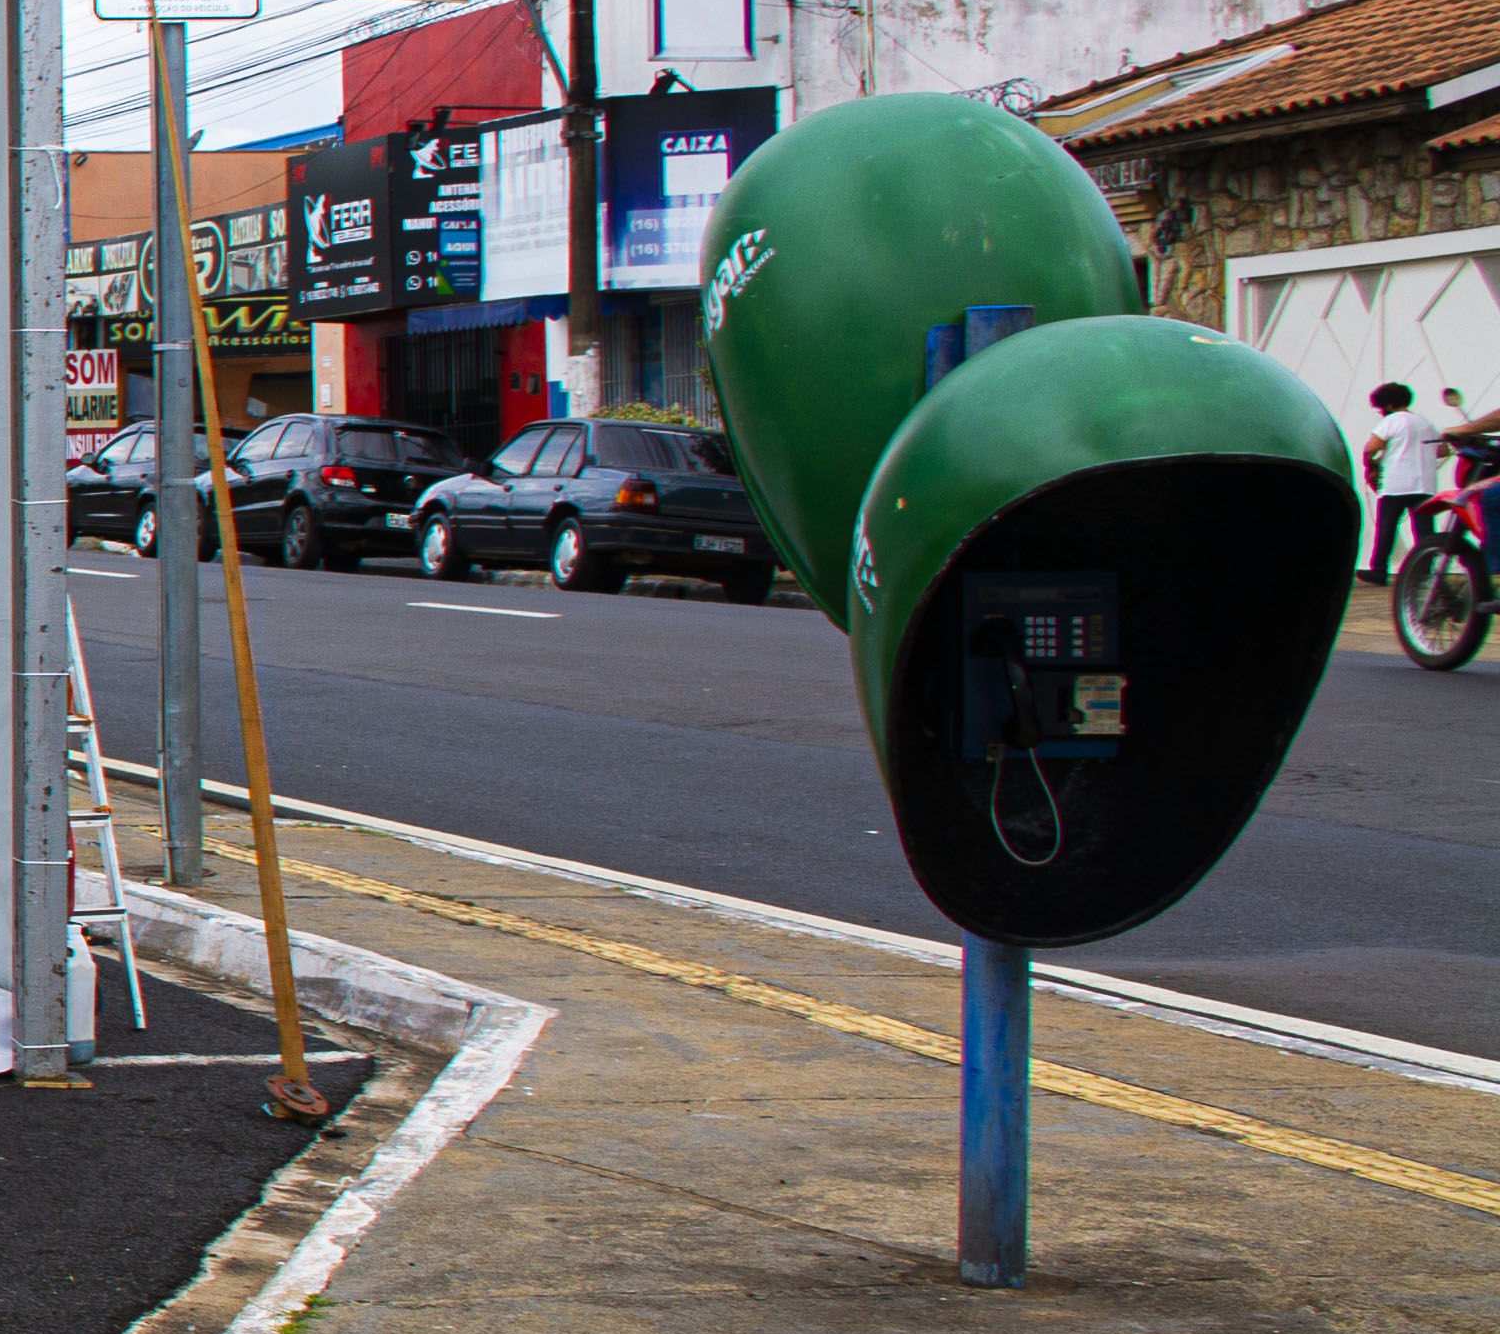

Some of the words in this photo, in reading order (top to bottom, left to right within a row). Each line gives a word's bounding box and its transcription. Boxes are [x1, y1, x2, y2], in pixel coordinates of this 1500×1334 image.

[660, 134, 729, 153] CAIXA
[331, 198, 373, 230] FERA
[207, 332, 310, 347] Acessórios
[66, 352, 116, 386] SOM
[66, 394, 118, 421] ALARME
